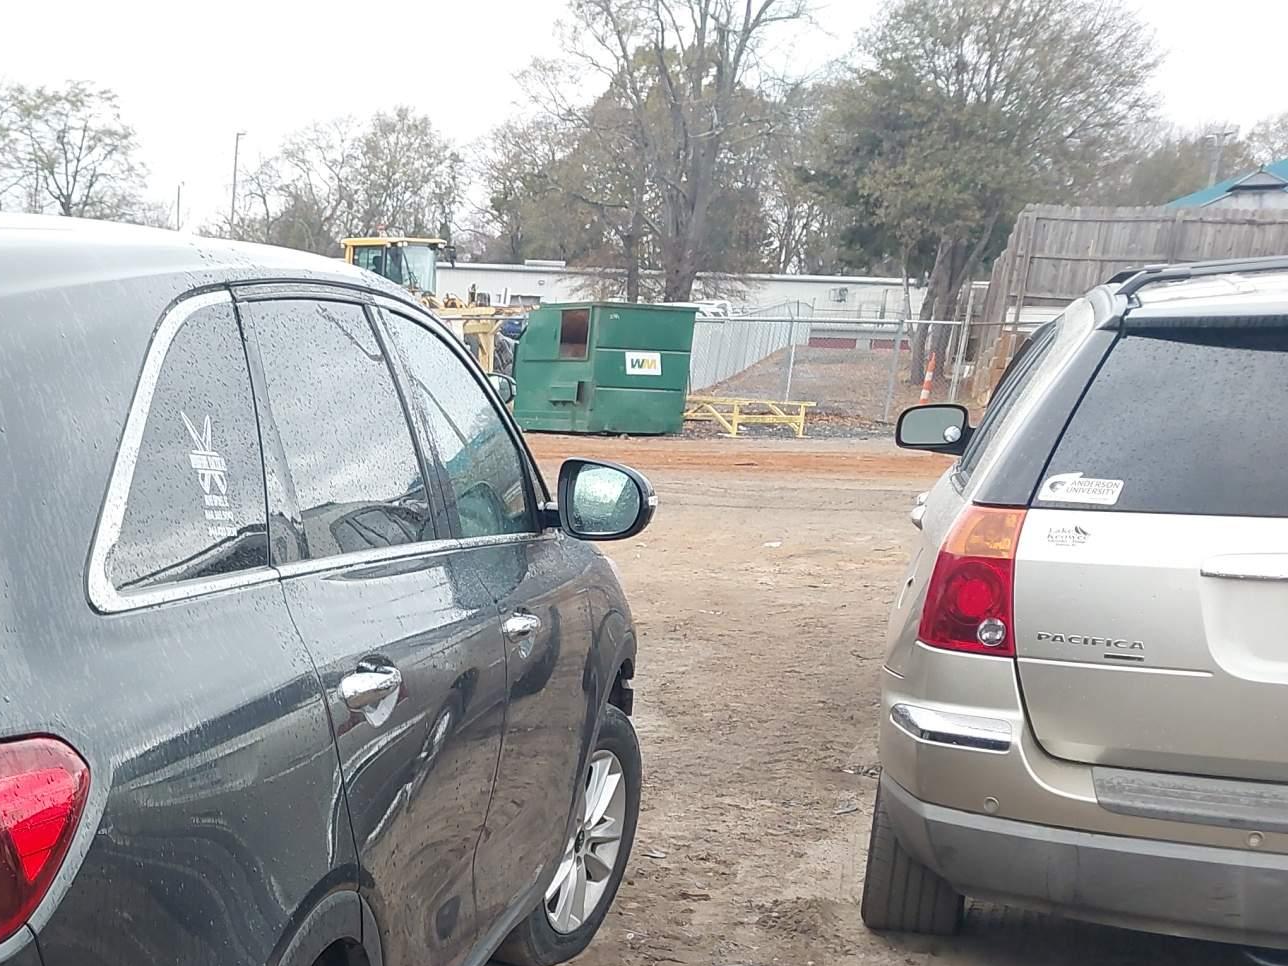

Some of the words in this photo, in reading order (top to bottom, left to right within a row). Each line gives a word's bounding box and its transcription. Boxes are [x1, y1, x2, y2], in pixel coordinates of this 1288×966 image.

[630, 358, 657, 369] WM
[1070, 480, 1120, 489] ANDERSON
[1066, 487, 1116, 495] UNIVERSITY
[1037, 631, 1144, 650] PACIFICA
